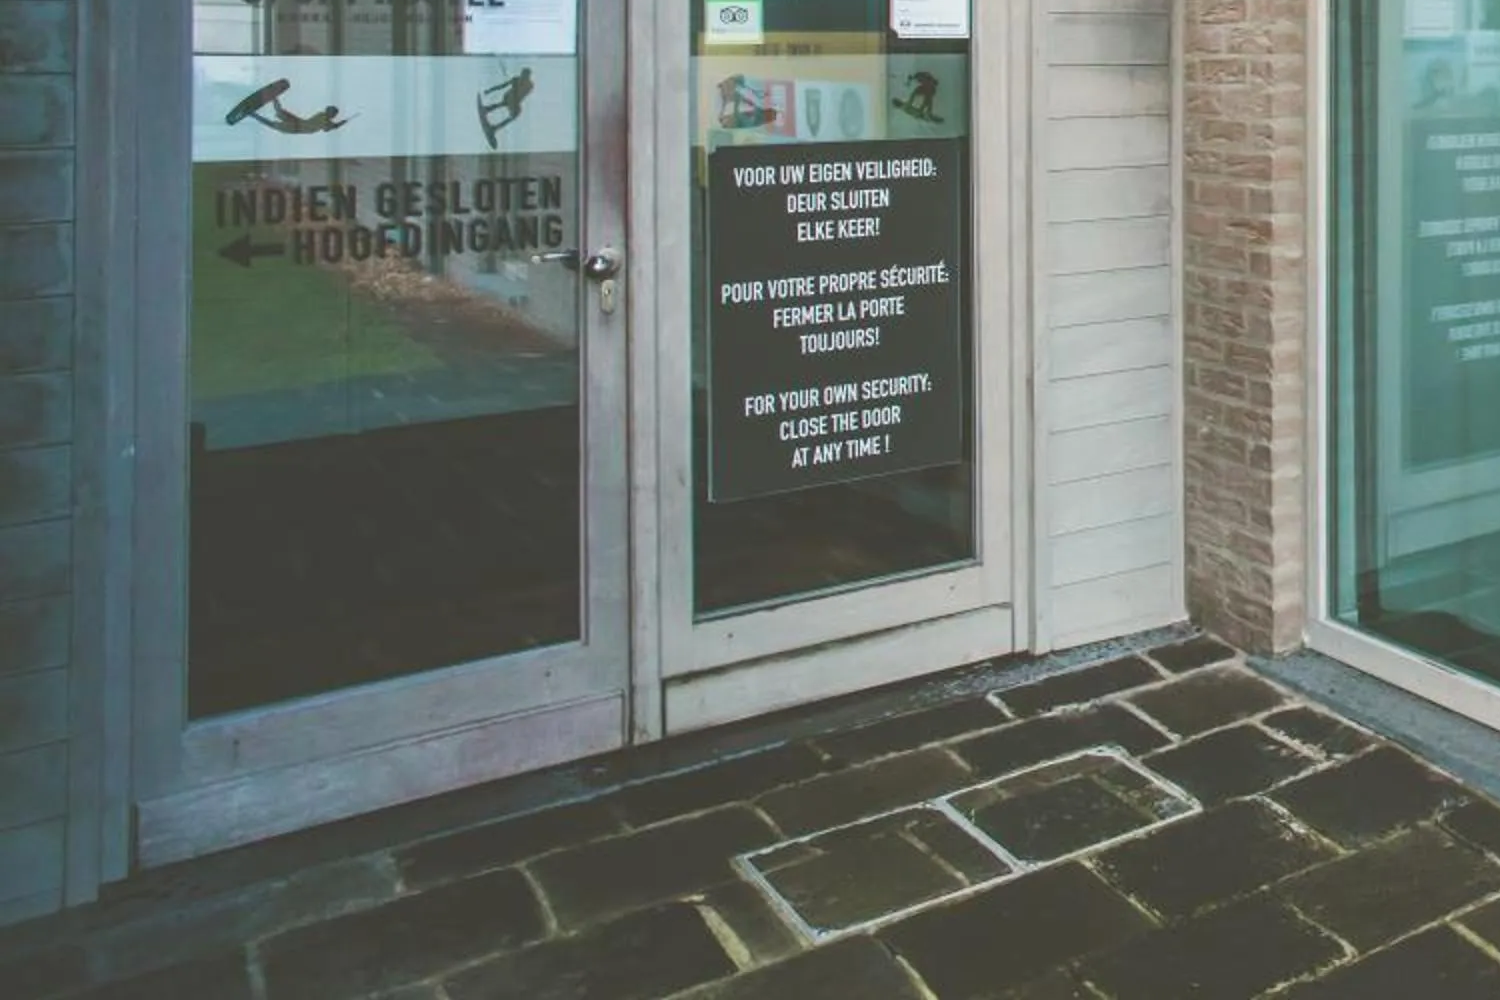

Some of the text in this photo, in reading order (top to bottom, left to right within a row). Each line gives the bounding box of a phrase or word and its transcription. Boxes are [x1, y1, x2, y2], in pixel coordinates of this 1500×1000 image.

[734, 158, 937, 188] VOOR UW EIGEN VEILIGHEID:
[216, 176, 562, 229] INDIEN GESLOTEN
[787, 188, 890, 213] DEUR SLUITEN
[797, 217, 880, 242] ELKE KEER!
[721, 281, 763, 305] POUR
[767, 275, 815, 299] VOTRE
[818, 269, 877, 295] PROPRE
[773, 296, 905, 328] FERMER LA PORTE
[800, 326, 880, 354] TOUJOURS!
[745, 372, 932, 416] FOR YOUR OWN SECURITY:
[779, 405, 901, 441] CLOSE THE DOOR
[791, 447, 809, 468] AT
[812, 441, 843, 465] ANY
[845, 435, 881, 459] TIME
